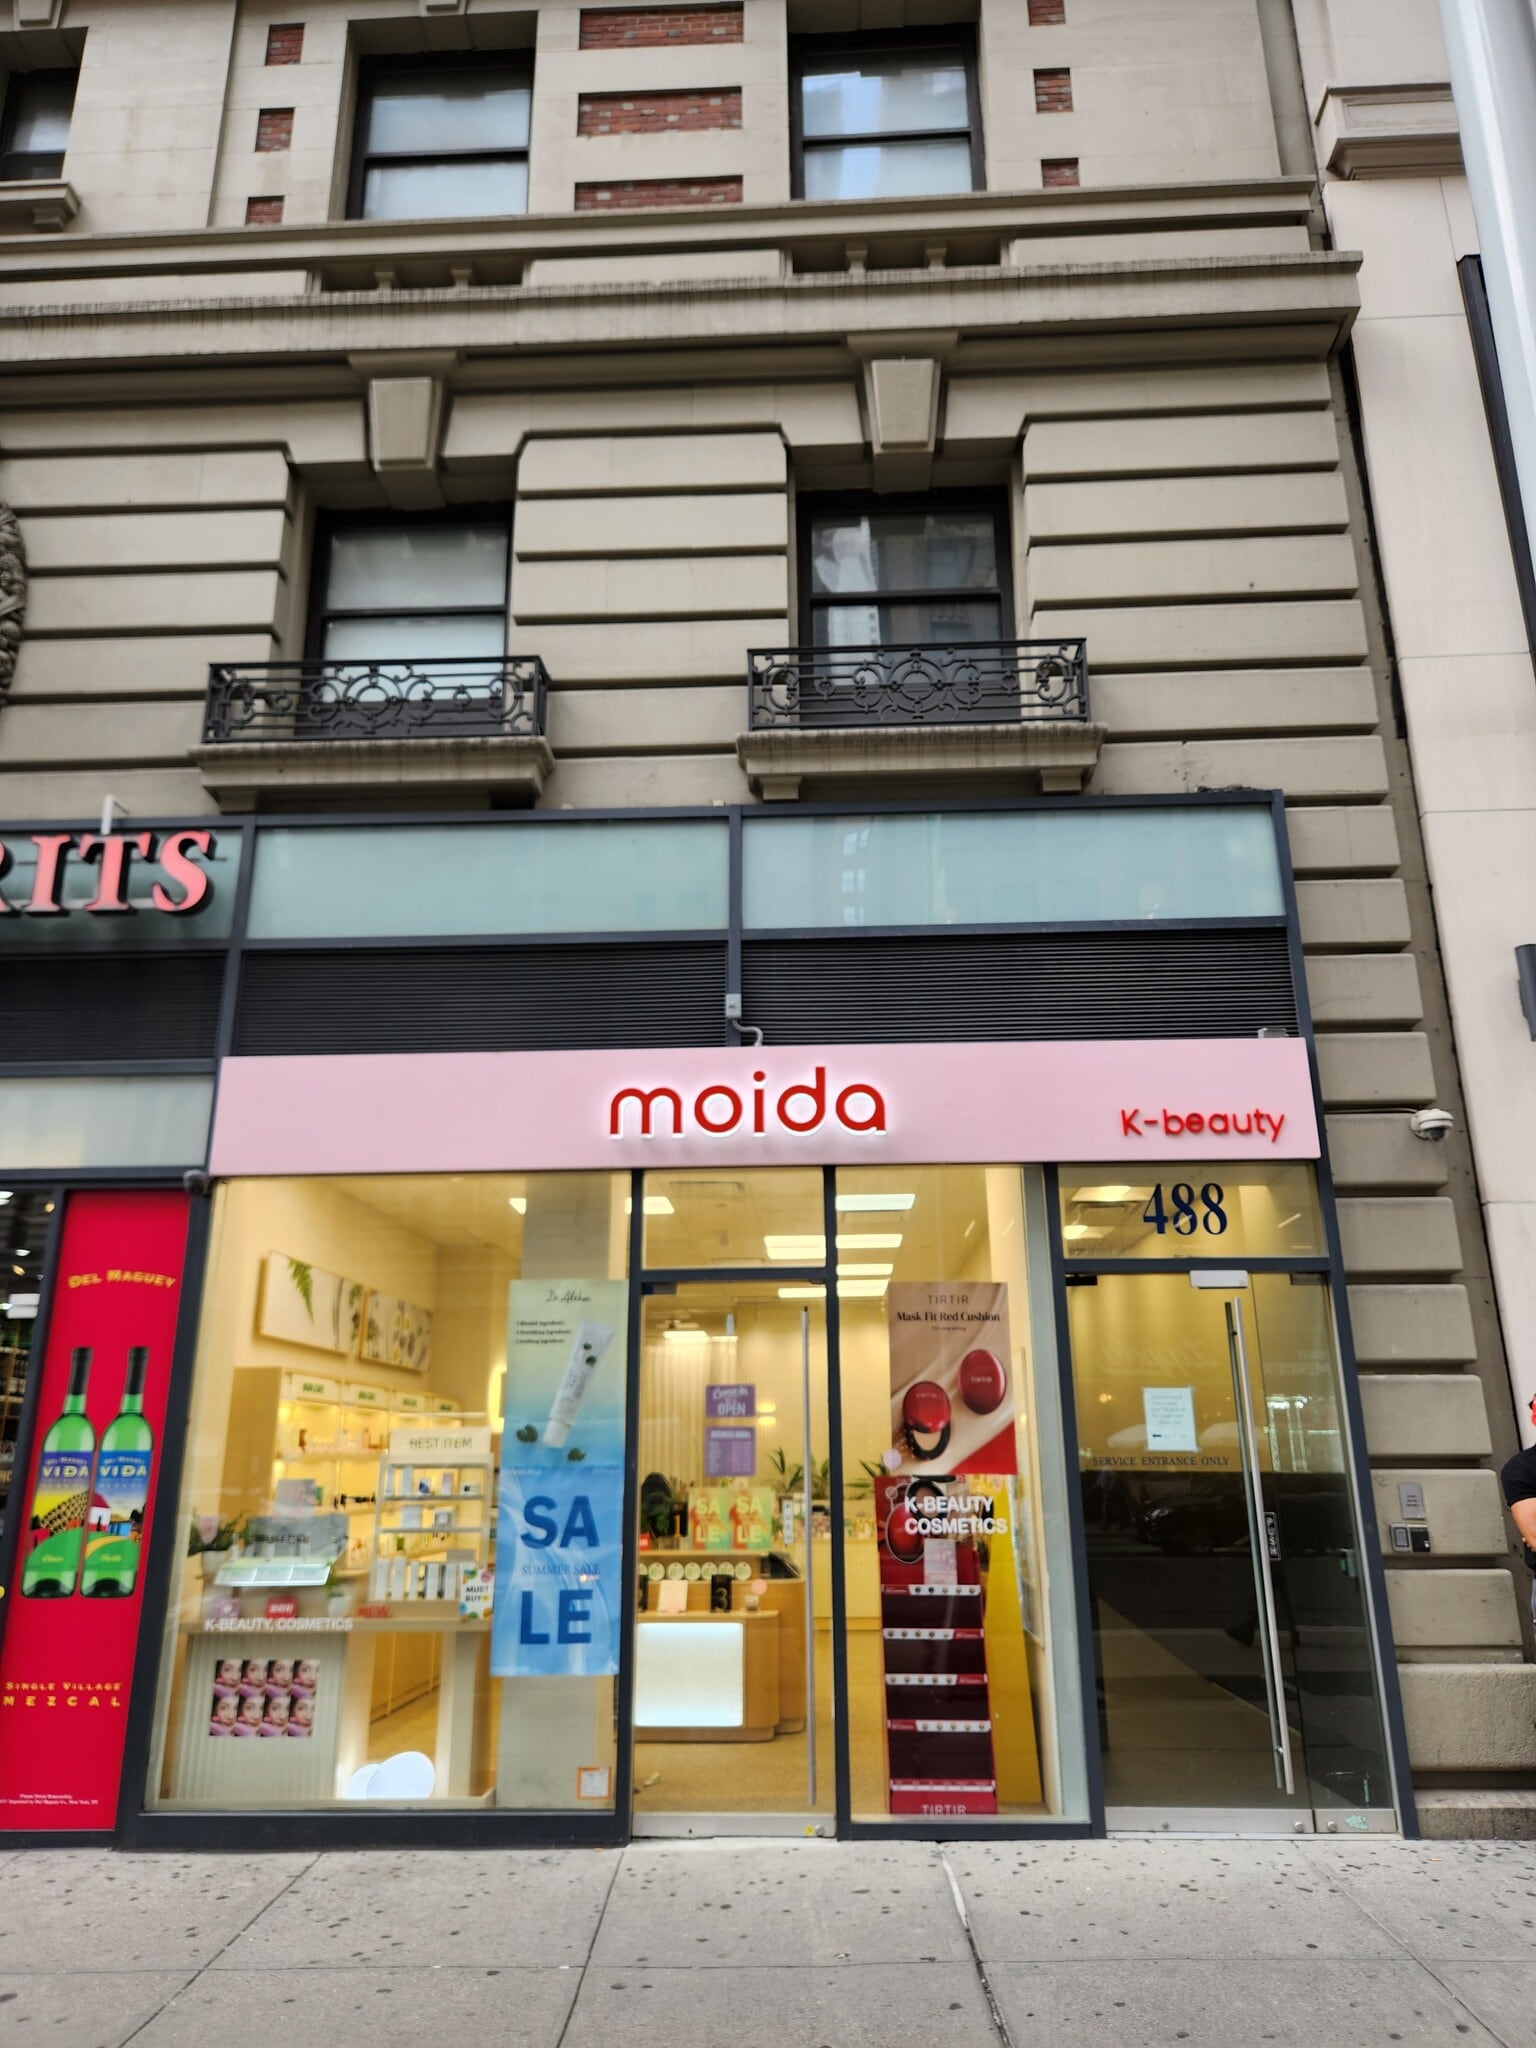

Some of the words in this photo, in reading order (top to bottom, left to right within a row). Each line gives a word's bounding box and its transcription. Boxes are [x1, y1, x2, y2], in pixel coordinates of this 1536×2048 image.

[0, 831, 214, 912] ITS
[610, 1066, 887, 1136] moida
[1121, 1108, 1285, 1143] K-beauty
[1143, 1183, 1228, 1235] 488
[68, 1273, 103, 1289] DEL
[106, 1269, 176, 1289] MAGUEY
[927, 1294, 969, 1305] TIRTIR
[897, 1311, 921, 1321] Mask
[924, 1311, 937, 1321] Fit
[940, 1311, 959, 1321] Red
[960, 1311, 1000, 1321] Cushion
[717, 1402, 747, 1416] OPEN
[409, 1437, 440, 1449] BEST
[443, 1437, 473, 1449] ITEM
[1092, 1456, 1137, 1466] SERVICE
[1140, 1456, 1198, 1466] ENTRANCE
[1201, 1456, 1230, 1466] ONLY
[42, 1465, 89, 1478] VIDA
[99, 1465, 147, 1478] VIDA
[904, 1496, 993, 1513] K-BEAUTY
[520, 1496, 600, 1549] SA
[904, 1518, 1008, 1535] COSMETICS
[522, 1564, 570, 1576] SUMMER
[276, 1617, 353, 1631] COSMETICS
[520, 1589, 593, 1645] LE
[5, 1682, 56, 1691] SINGLE
[62, 1682, 122, 1691] VILLAGE
[3, 1696, 121, 1707] MEZCAL
